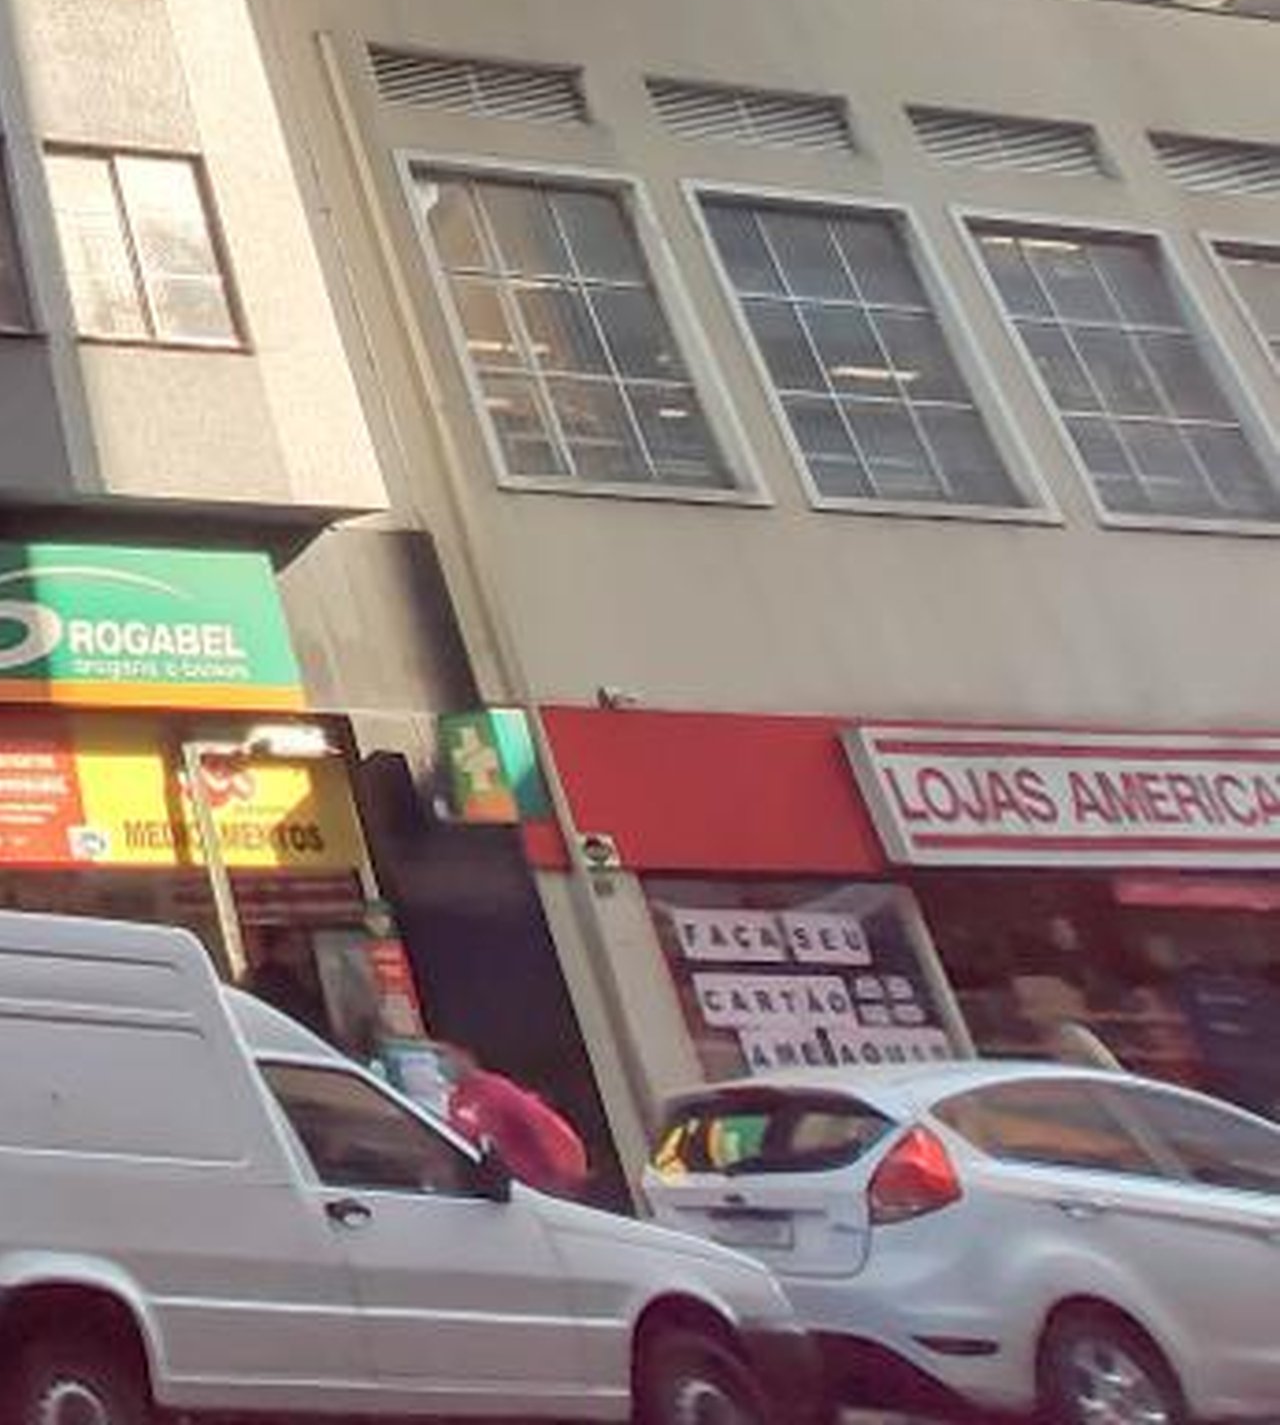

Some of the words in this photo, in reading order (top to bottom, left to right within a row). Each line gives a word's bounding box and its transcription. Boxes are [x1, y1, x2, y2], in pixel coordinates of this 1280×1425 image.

[883, 766, 1059, 825] LOJAS
[1068, 771, 1280, 828] AMERICA
[792, 926, 864, 952] SEU
